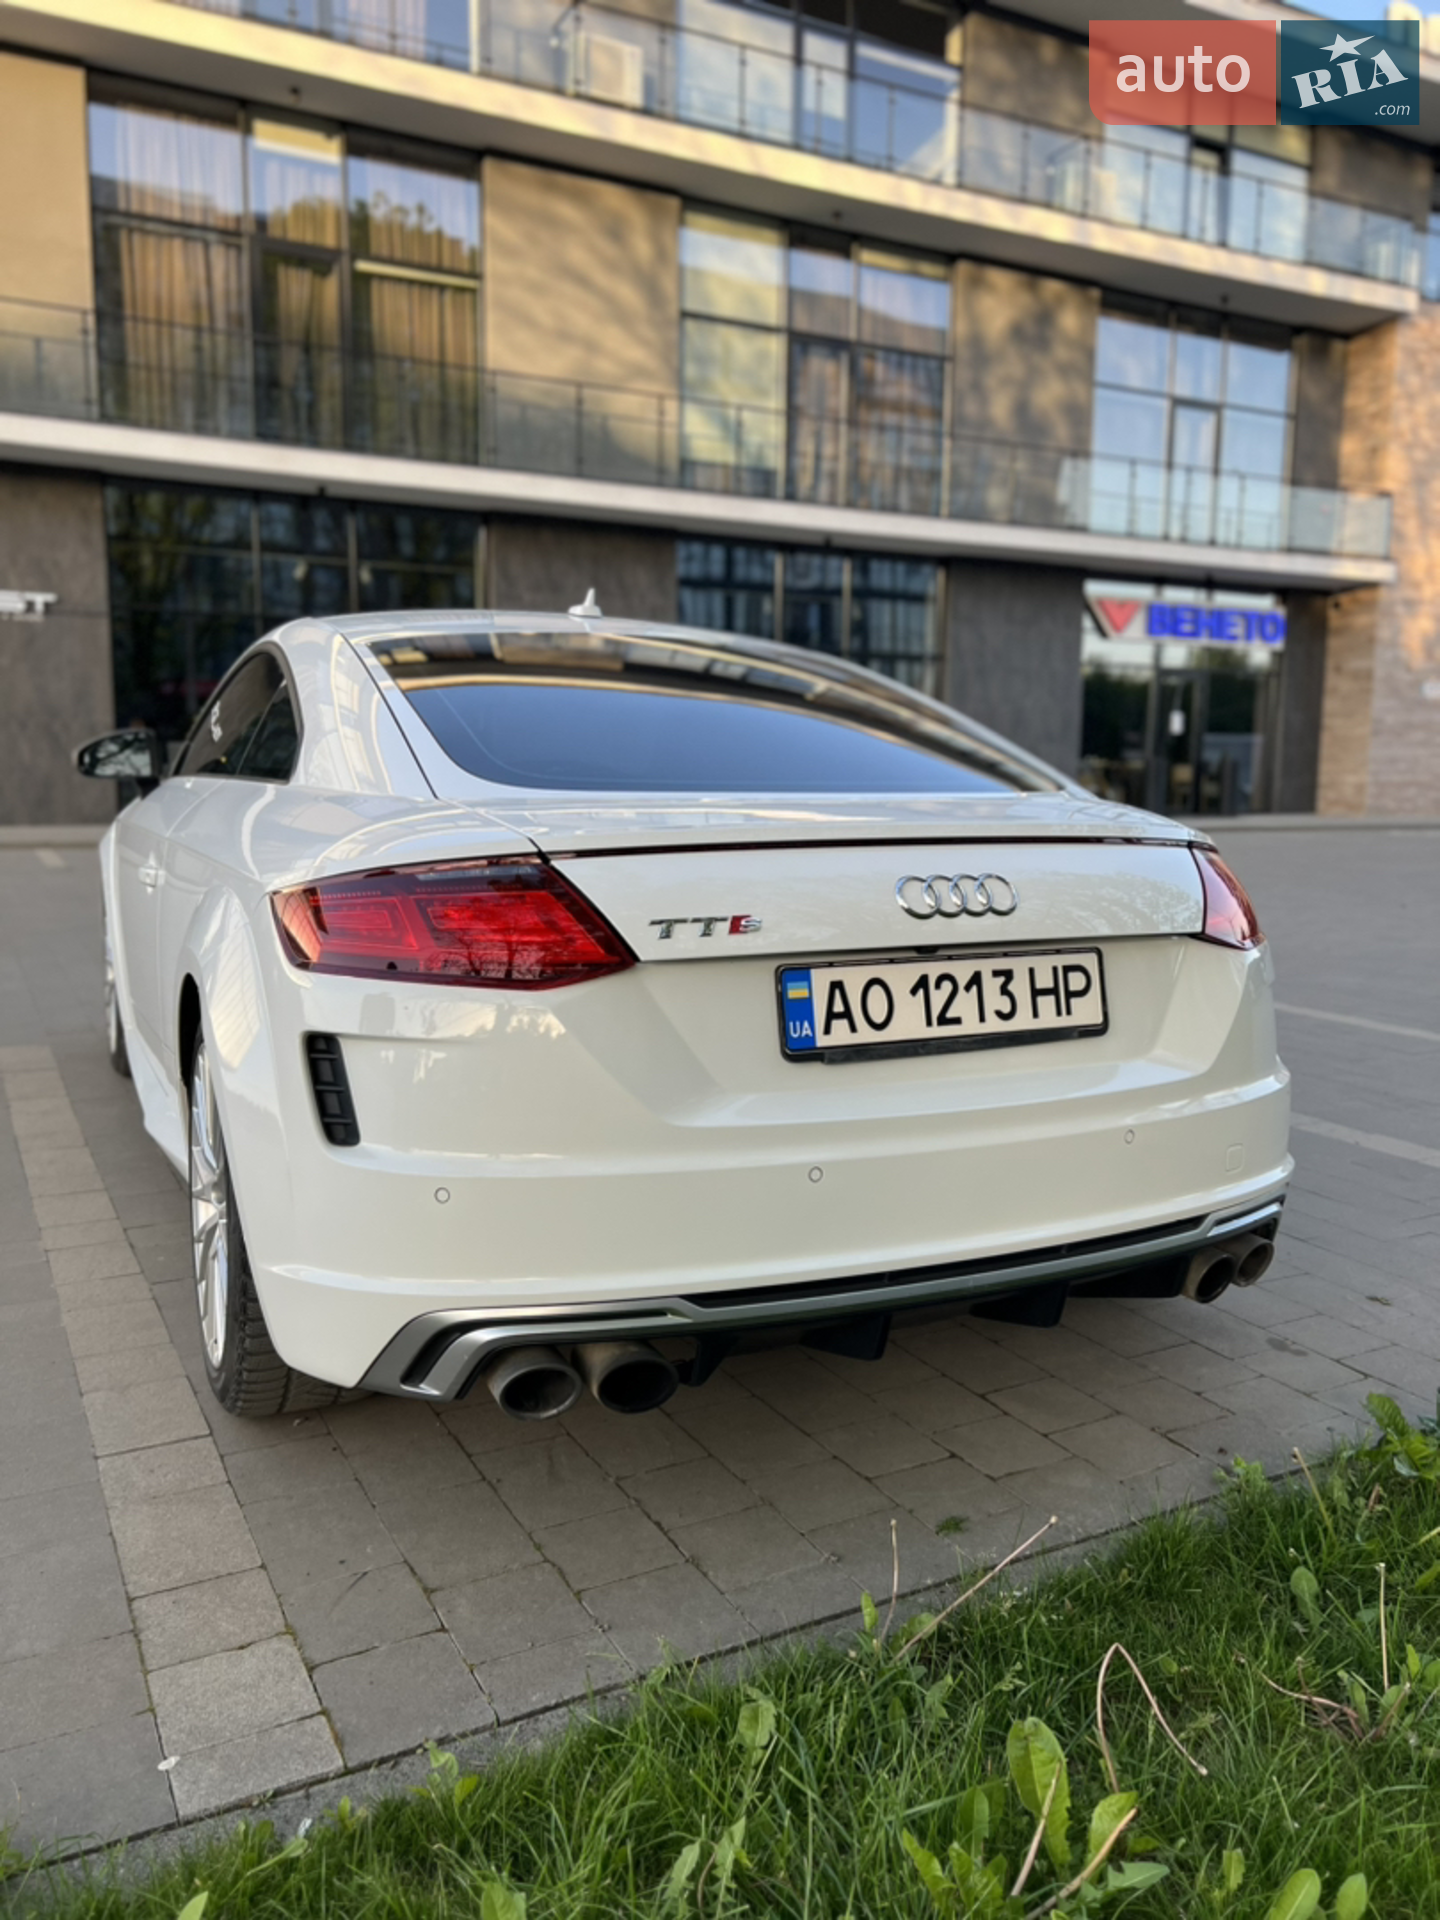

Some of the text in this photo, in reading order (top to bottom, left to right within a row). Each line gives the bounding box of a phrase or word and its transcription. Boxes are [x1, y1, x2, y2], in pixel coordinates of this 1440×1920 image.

[649, 914, 762, 940] TTS
[823, 964, 1092, 1035] AO 1213 HP
[789, 1019, 813, 1038] UA
